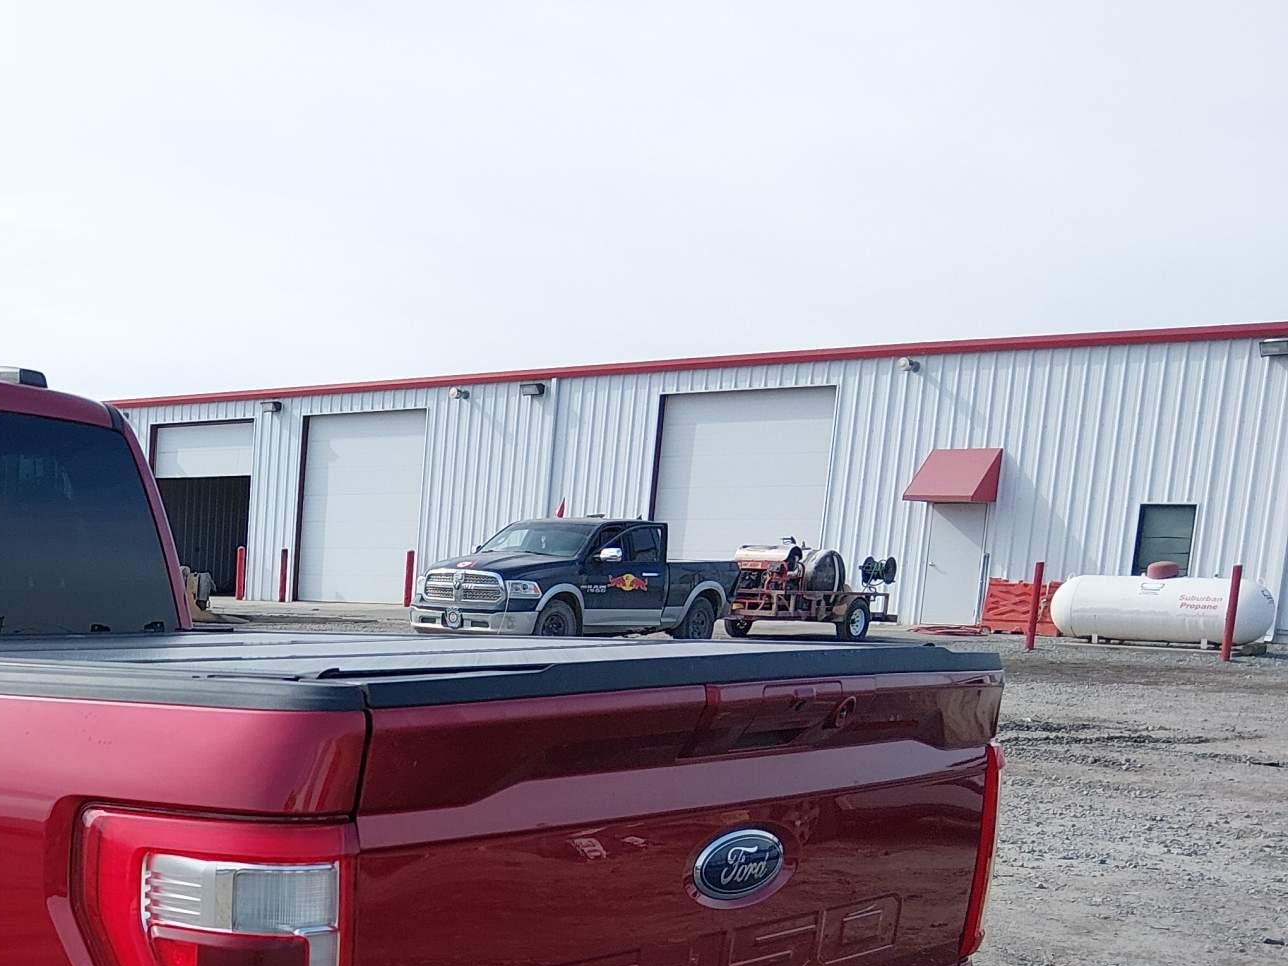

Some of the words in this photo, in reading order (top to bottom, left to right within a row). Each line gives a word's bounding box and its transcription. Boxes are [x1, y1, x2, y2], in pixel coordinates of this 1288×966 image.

[1178, 593, 1223, 603] Suburban
[1179, 602, 1218, 610] Propane
[720, 845, 770, 885] Ford
